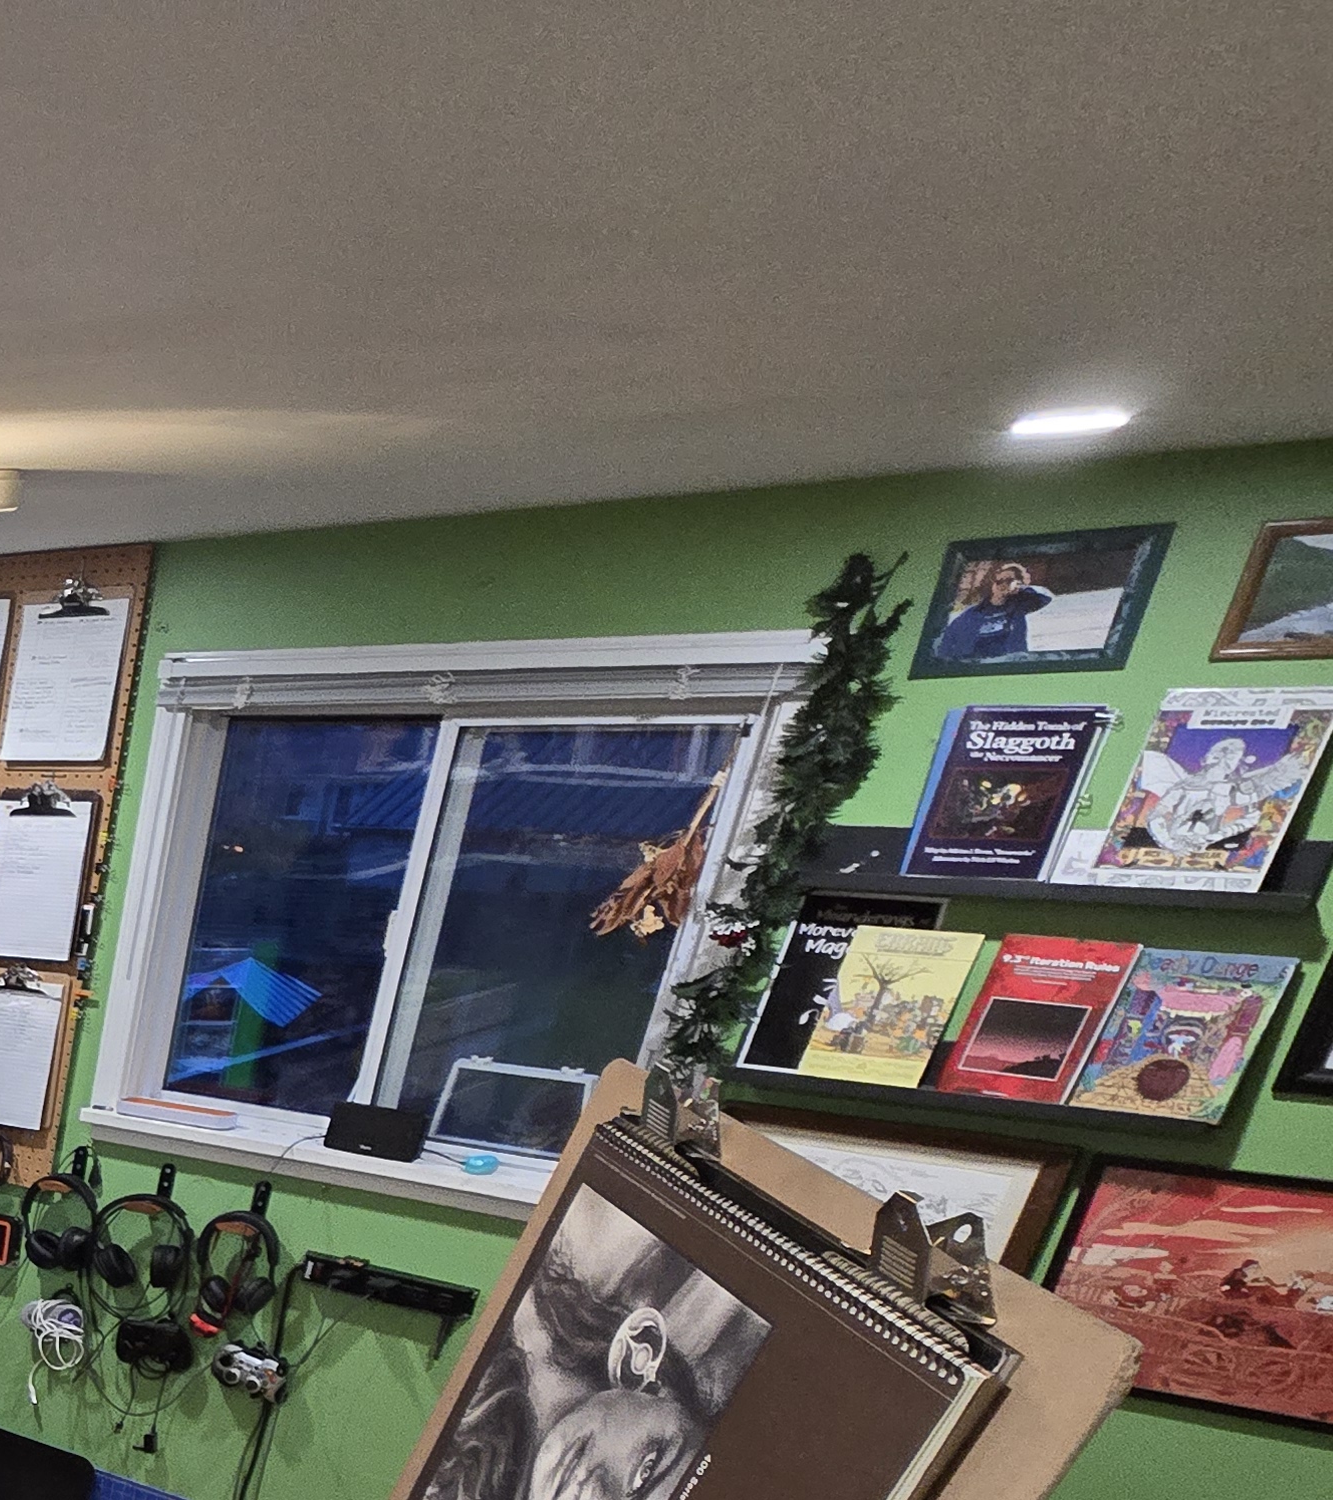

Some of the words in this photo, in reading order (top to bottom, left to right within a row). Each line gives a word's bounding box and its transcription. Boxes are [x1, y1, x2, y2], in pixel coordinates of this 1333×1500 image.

[969, 720, 991, 730] The
[993, 720, 1035, 730] Hidden
[966, 731, 1075, 754] Slaggoth
[984, 752, 1063, 762] Necromancer
[696, 1454, 711, 1476] 400
